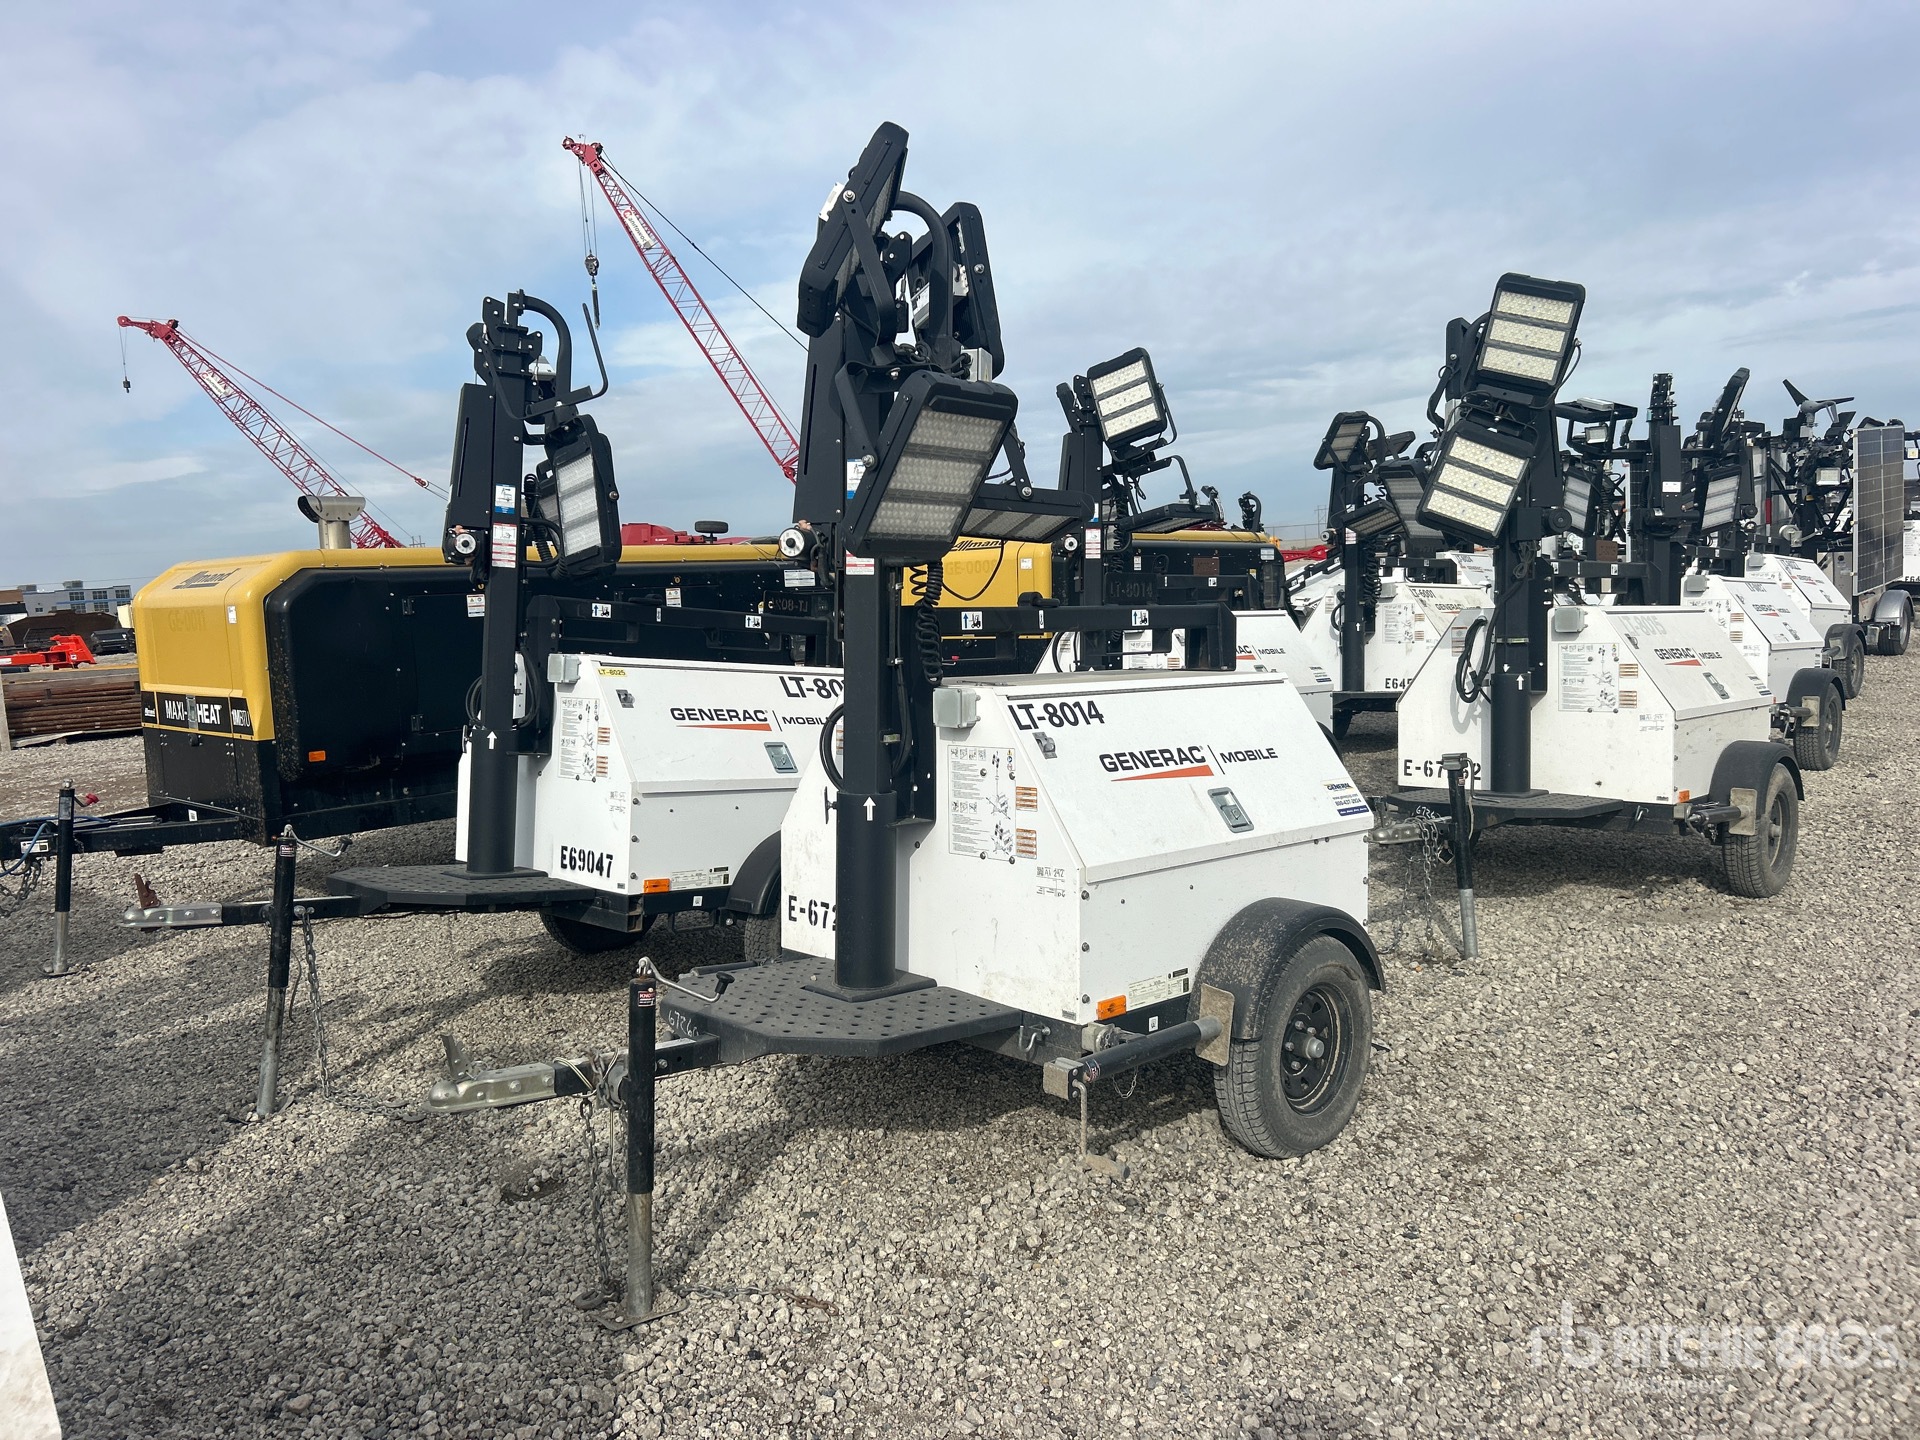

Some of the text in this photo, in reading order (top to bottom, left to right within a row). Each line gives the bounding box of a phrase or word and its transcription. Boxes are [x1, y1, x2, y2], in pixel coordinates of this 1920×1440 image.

[1654, 647, 1722, 660] GENERAC MOBILE
[779, 676, 844, 699] LT-80
[670, 707, 837, 725] GENERAC MOBIL
[1007, 700, 1105, 731] LT-8014
[1099, 746, 1279, 772] GENERAC MOBILE
[560, 845, 614, 878] E69047
